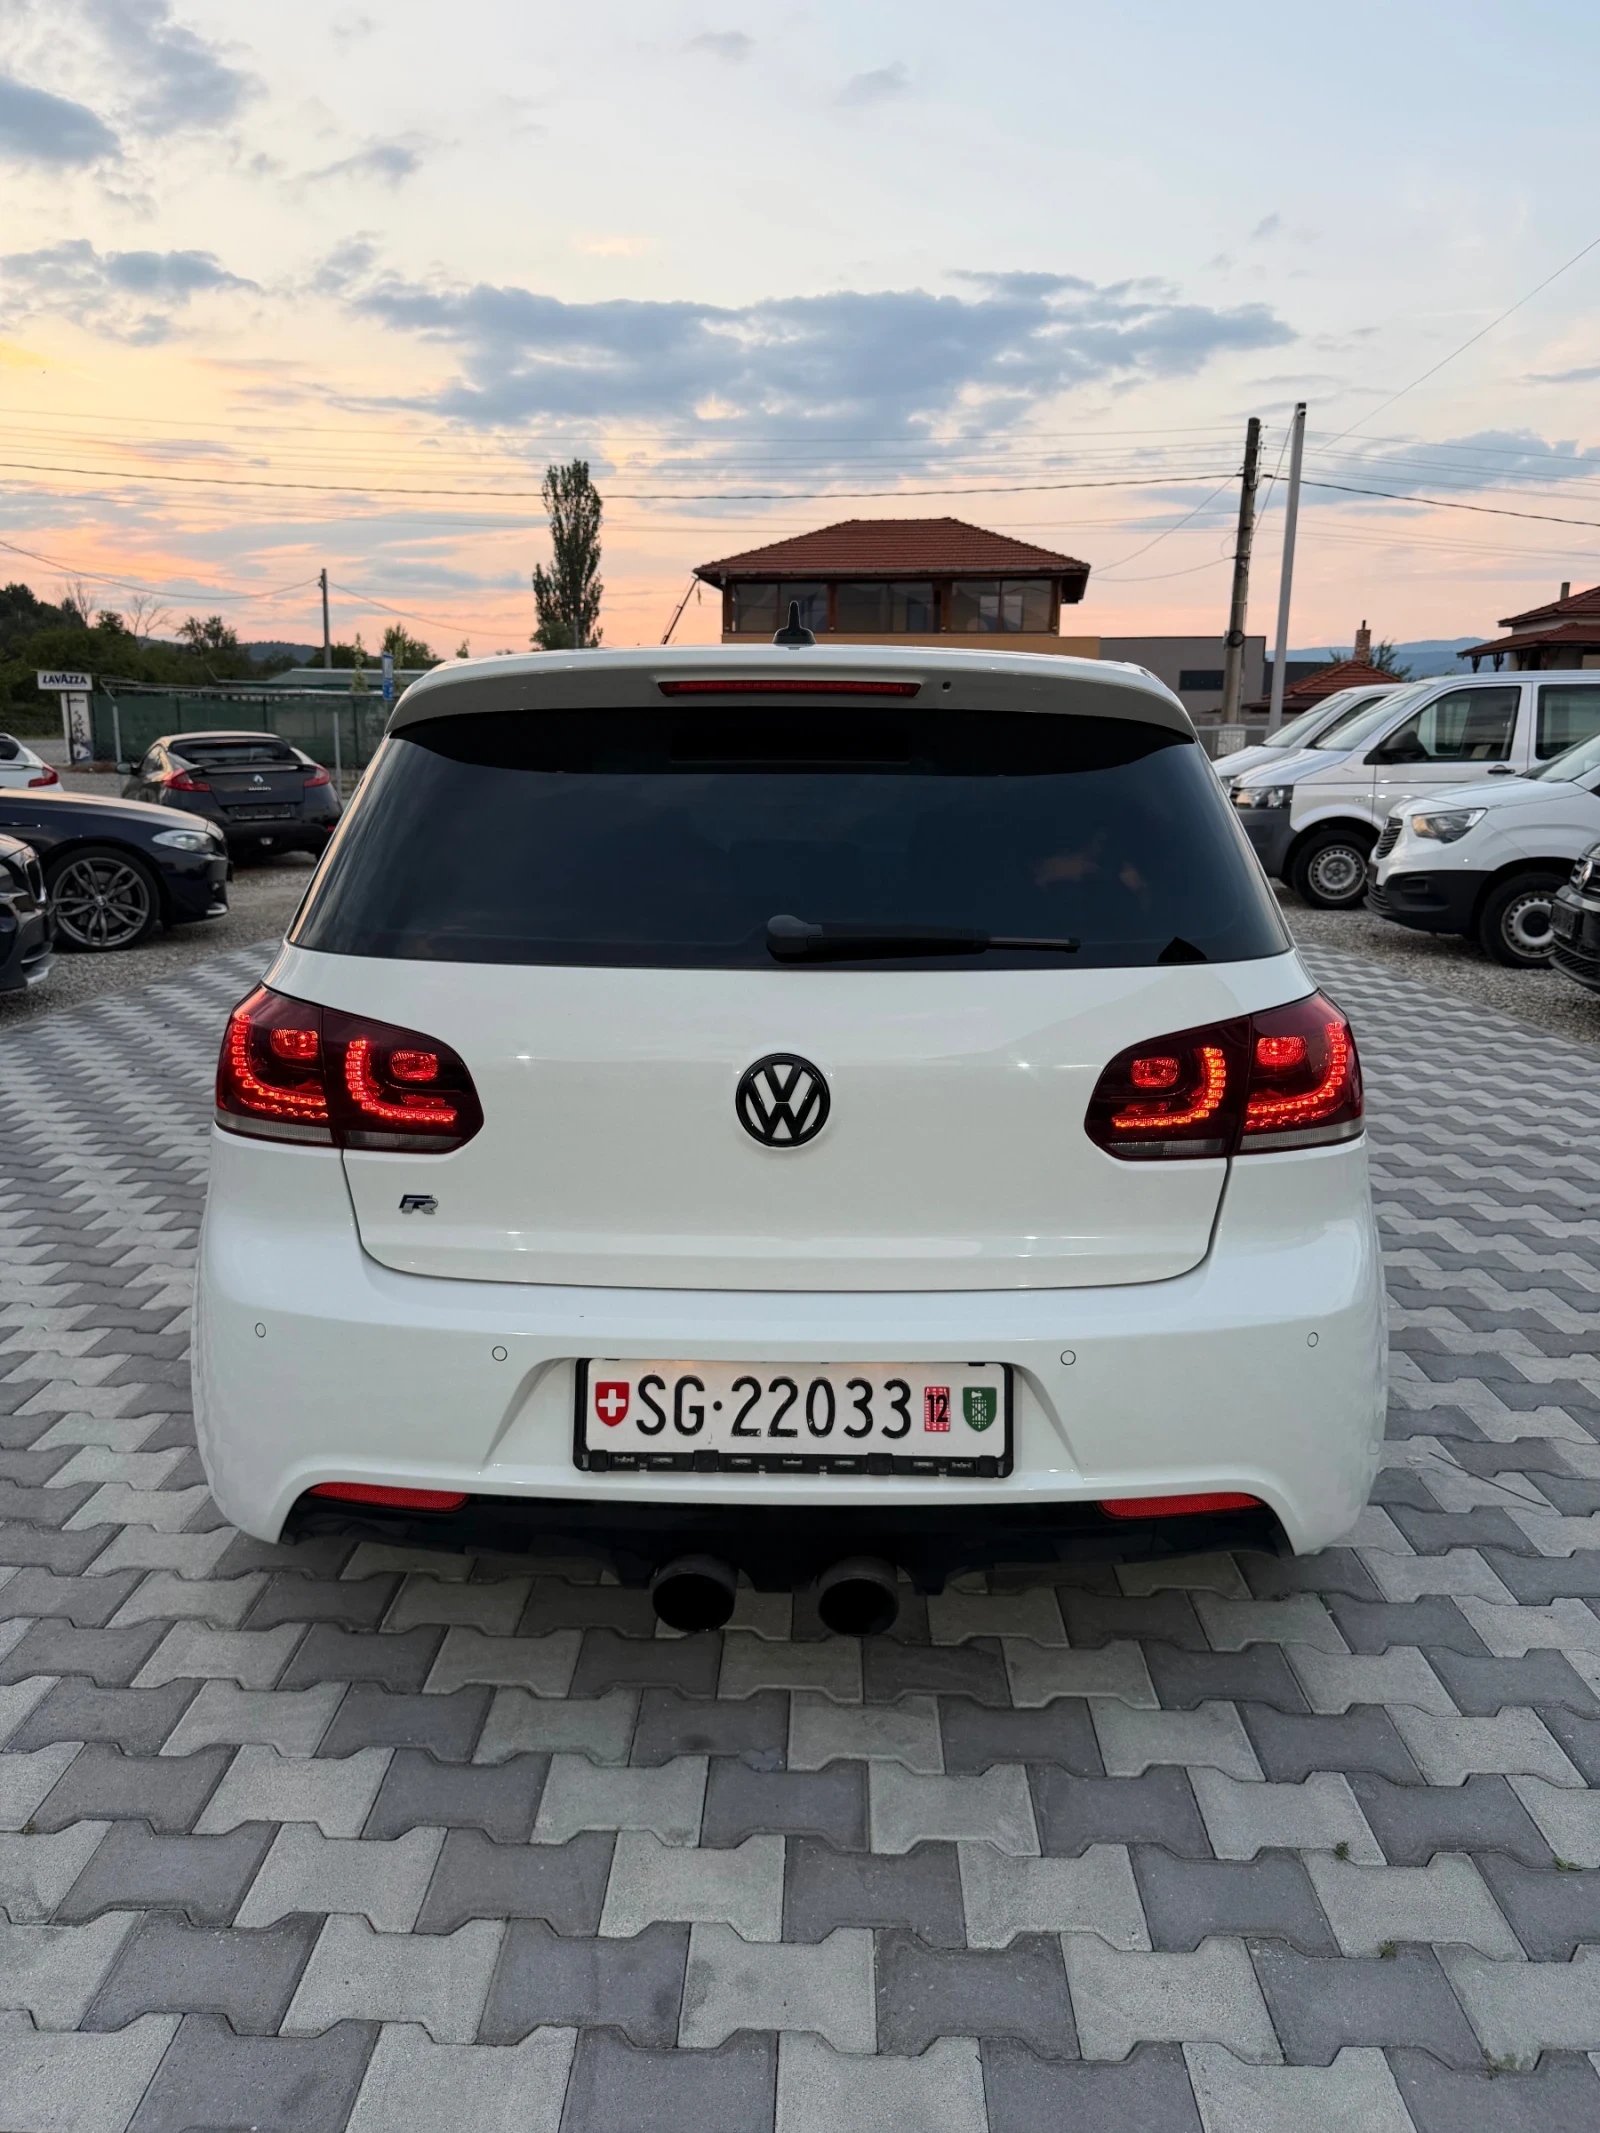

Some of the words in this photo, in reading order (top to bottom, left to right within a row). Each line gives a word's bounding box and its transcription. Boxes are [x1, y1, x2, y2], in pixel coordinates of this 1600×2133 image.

[42, 673, 88, 685] LAVAZZA
[739, 1057, 826, 1143] VW
[927, 1394, 949, 1423] 12
